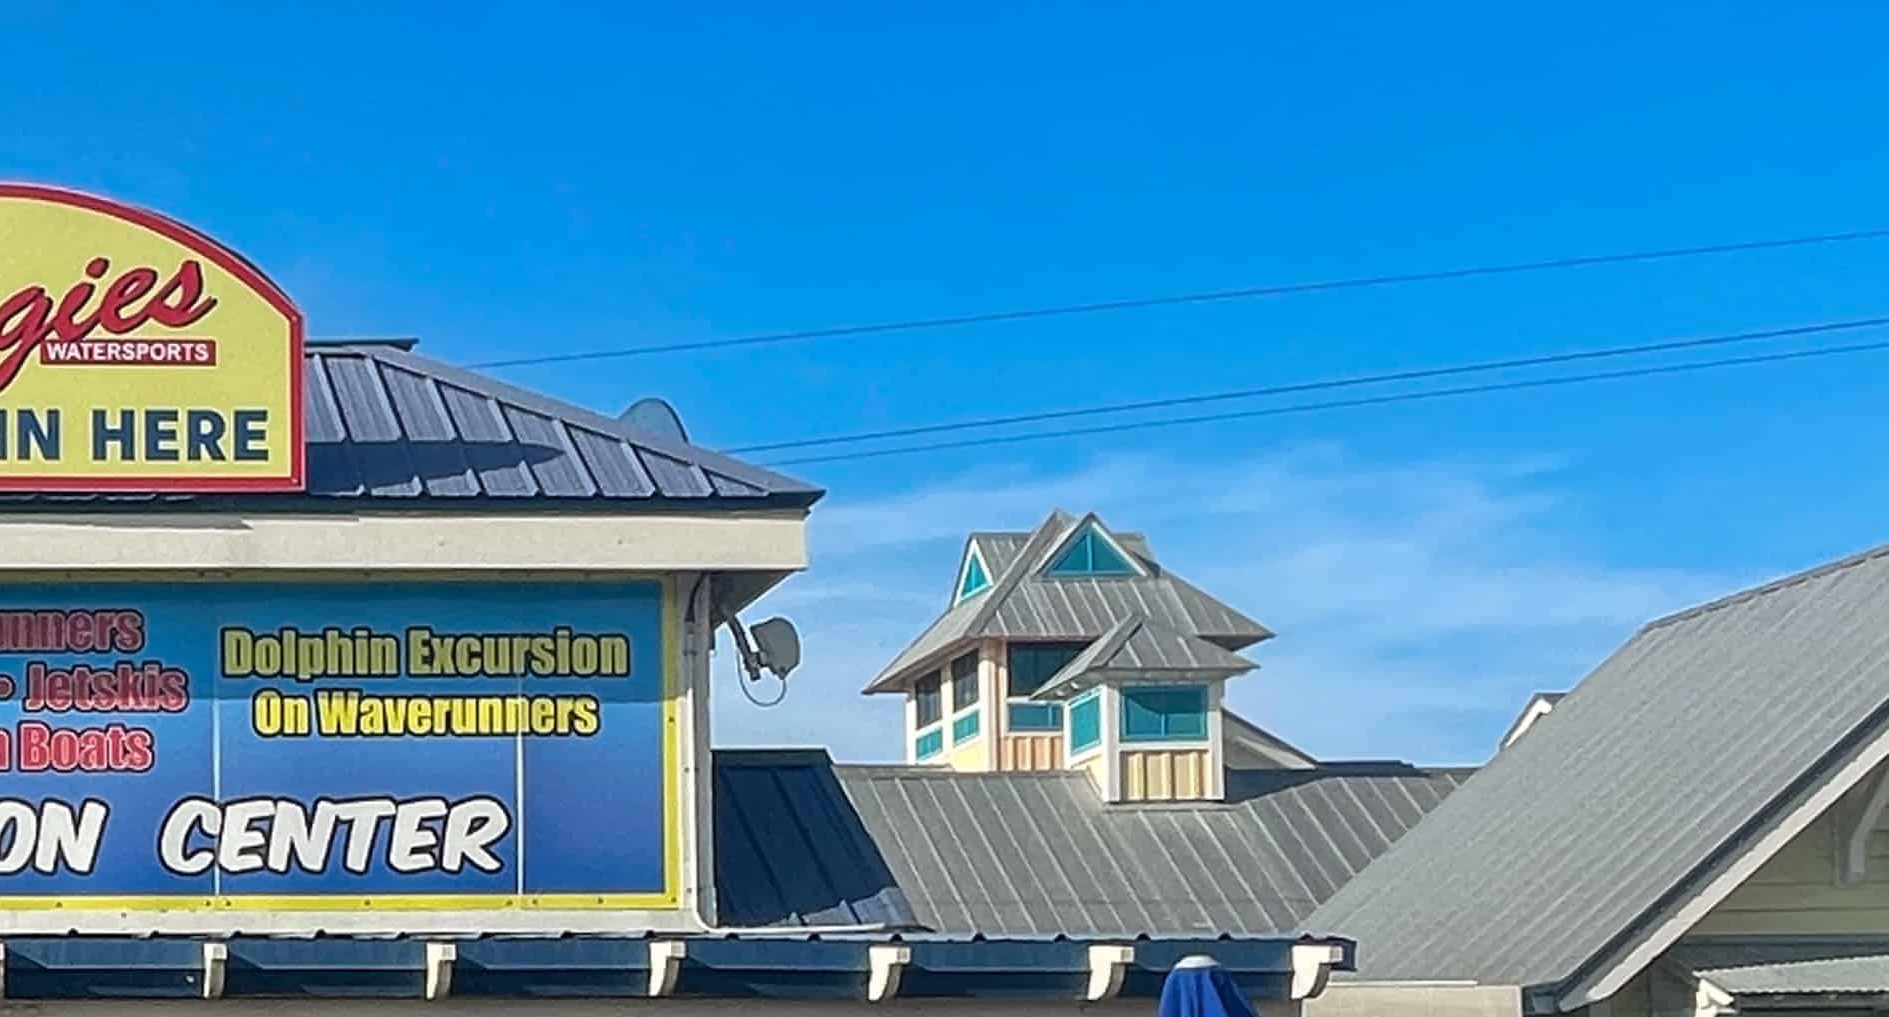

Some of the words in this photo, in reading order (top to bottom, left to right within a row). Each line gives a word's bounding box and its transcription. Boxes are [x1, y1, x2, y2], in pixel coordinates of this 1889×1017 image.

[47, 341, 209, 361] WATERSPORTS
[92, 409, 270, 461] HERE
[221, 628, 399, 678] Dolphin
[409, 628, 630, 677] Excursion
[25, 663, 189, 712] Jetskis
[253, 692, 309, 735] On
[316, 692, 601, 736] Waverunners
[19, 724, 153, 772] Boats
[158, 798, 511, 876] CENTER
